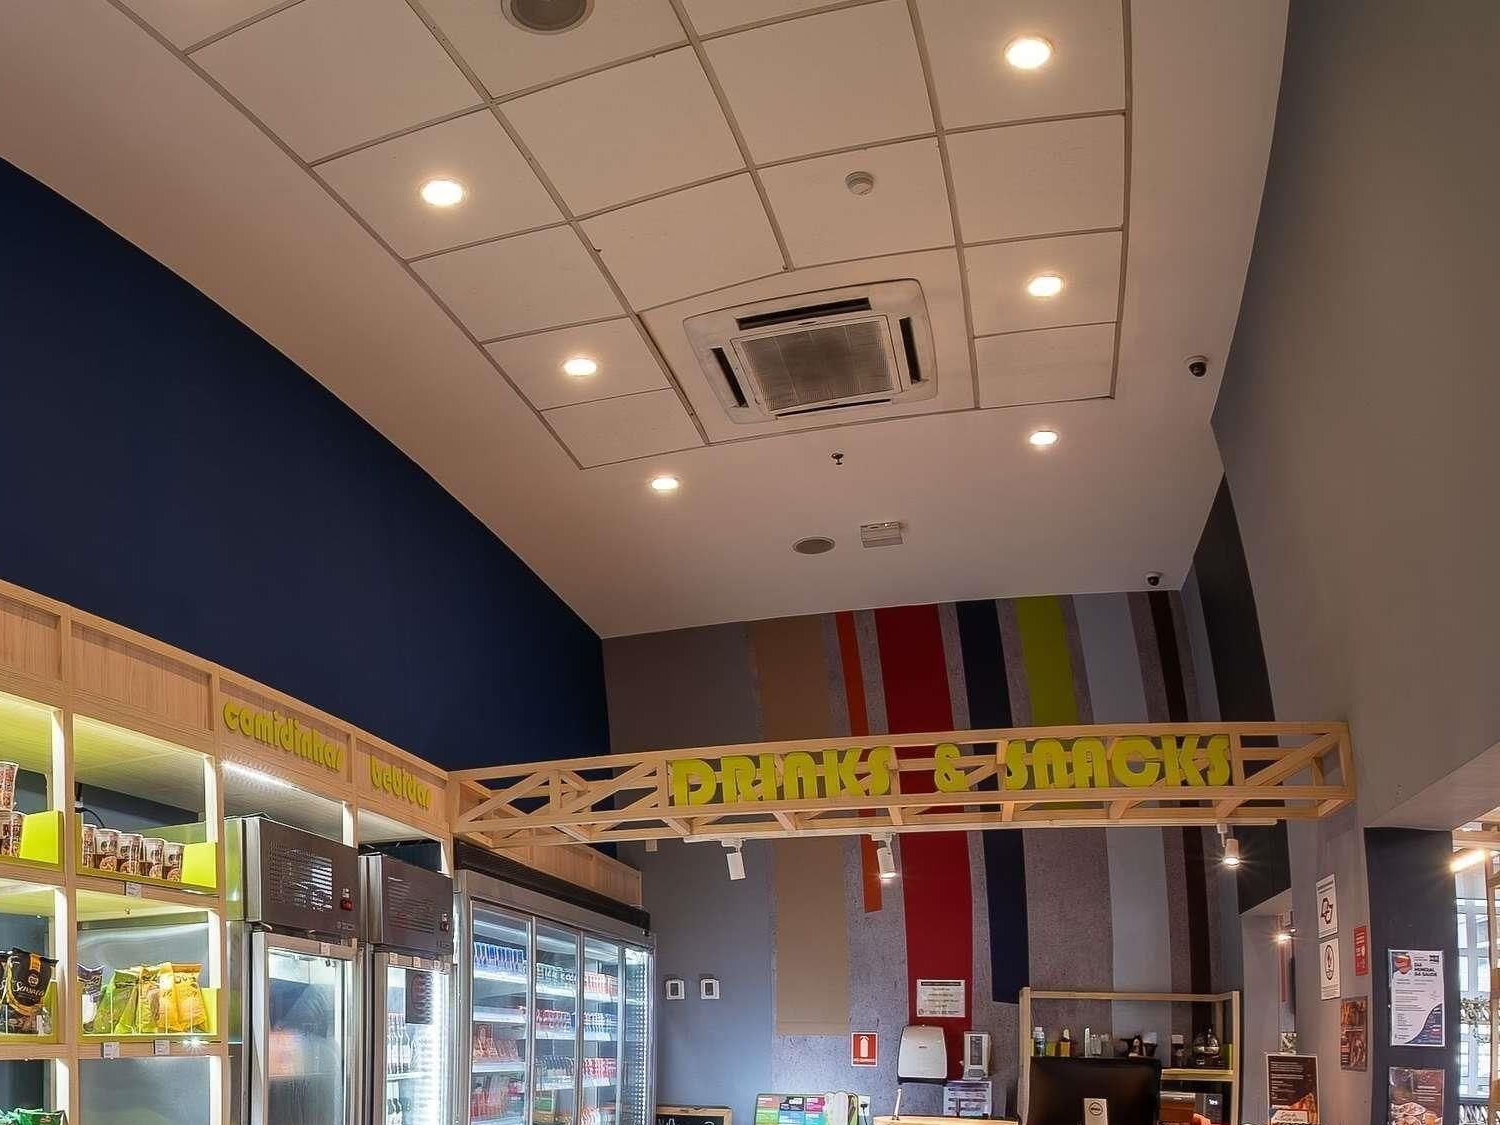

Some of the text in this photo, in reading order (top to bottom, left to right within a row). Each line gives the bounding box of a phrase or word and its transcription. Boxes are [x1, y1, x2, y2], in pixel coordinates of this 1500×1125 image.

[222, 700, 345, 774] comidinhas
[672, 734, 1232, 807] DRINKS & SNACKS
